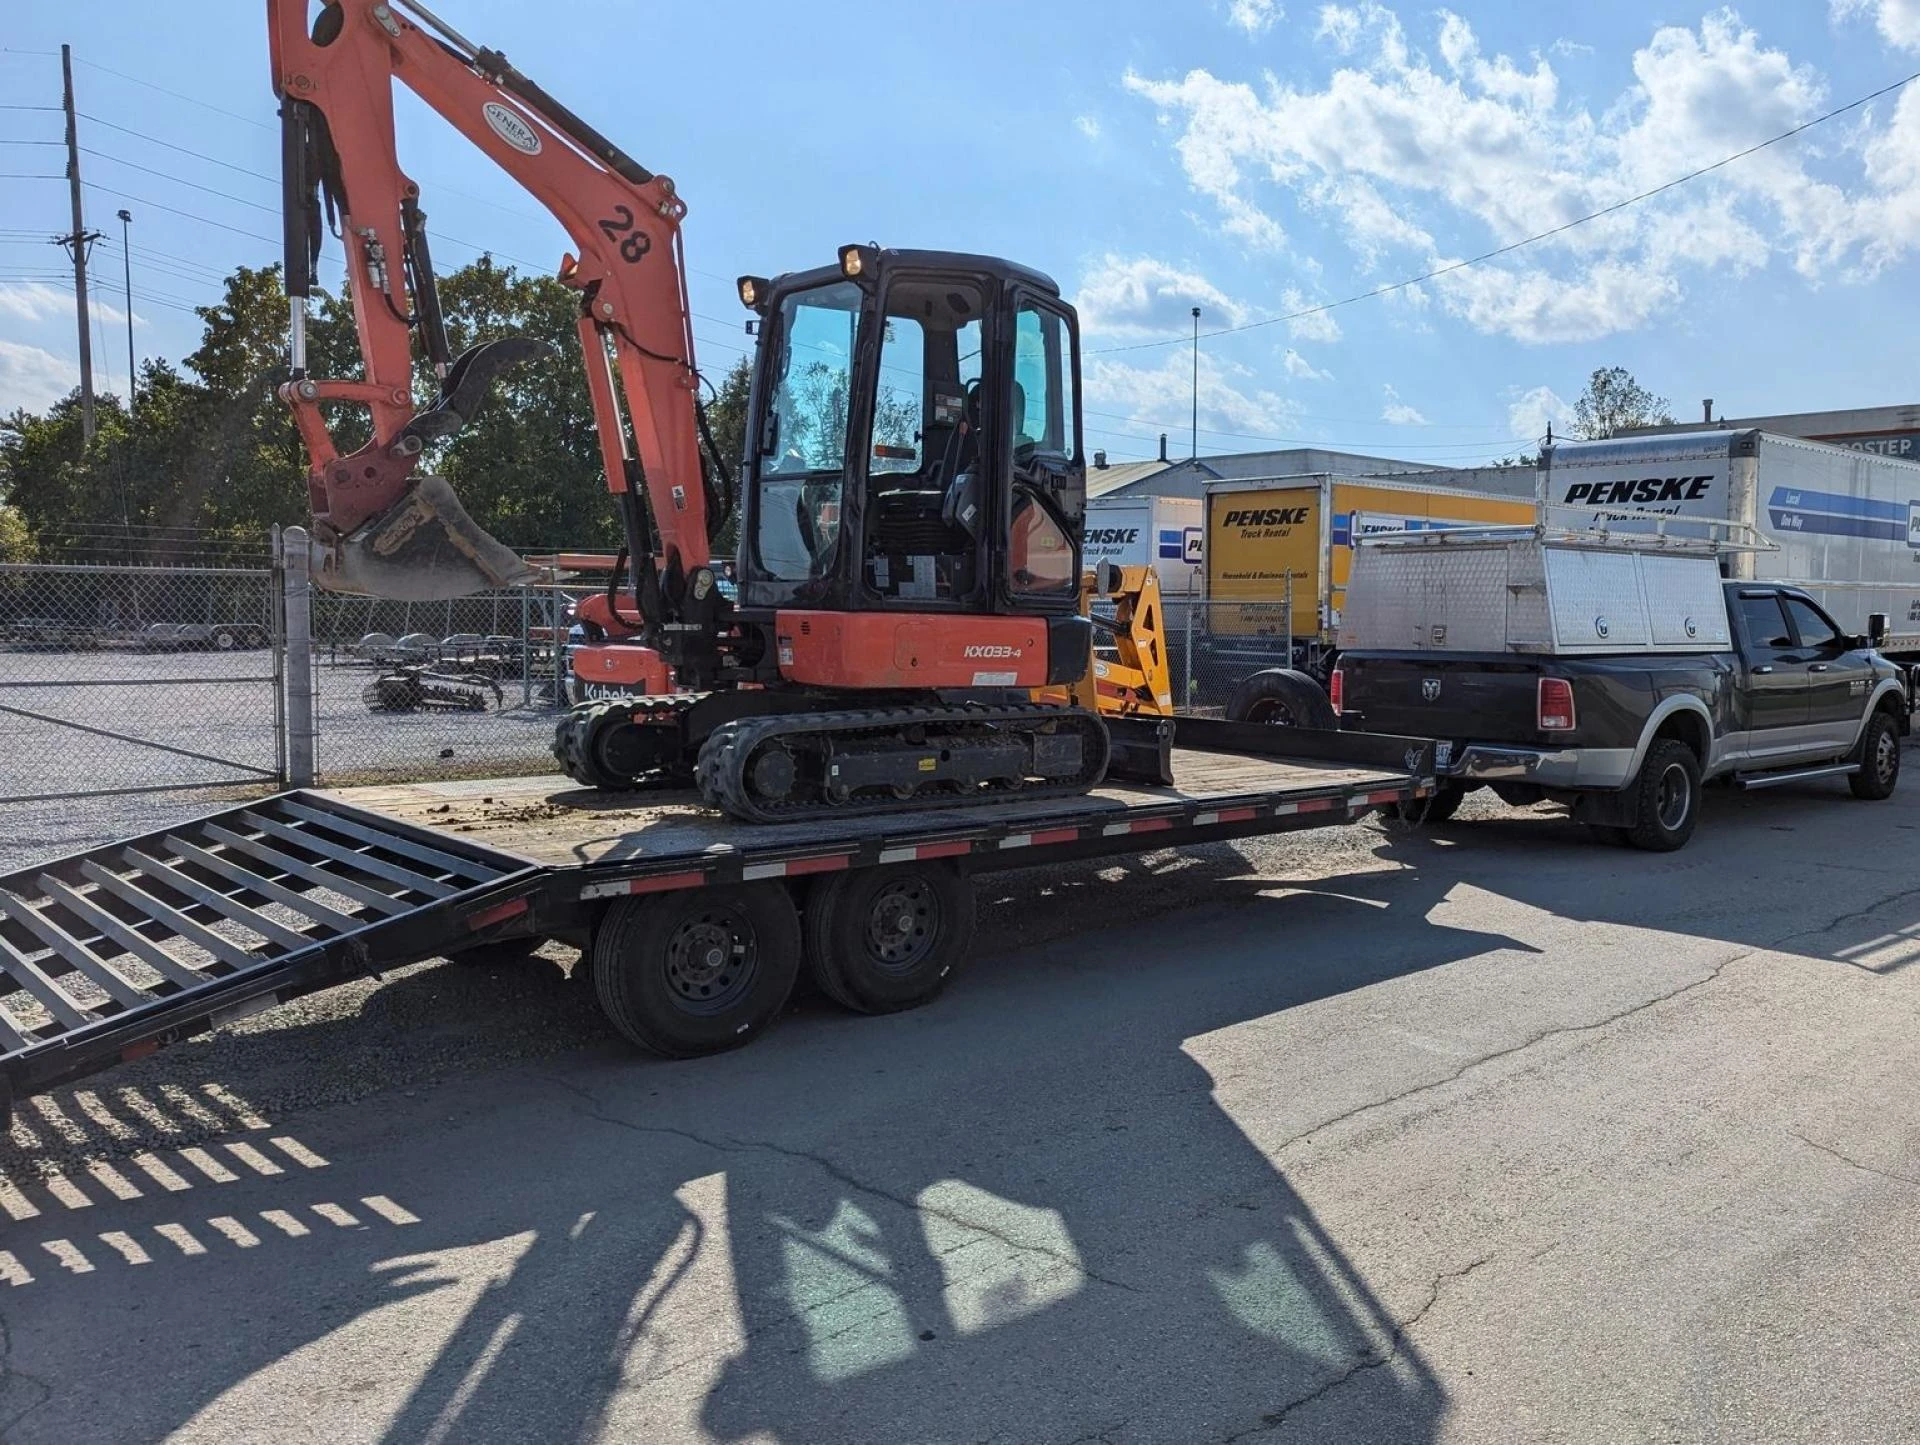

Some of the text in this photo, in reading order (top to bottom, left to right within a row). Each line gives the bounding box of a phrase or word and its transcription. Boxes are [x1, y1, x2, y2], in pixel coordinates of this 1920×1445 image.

[486, 104, 539, 148] GENERAL
[598, 204, 651, 264] 28
[1564, 475, 1715, 505] PENSKE
[1222, 507, 1310, 527] PENSKE
[1593, 504, 1681, 521] Tuck Rtal
[1084, 528, 1139, 545] ENSKE
[1240, 527, 1292, 539] Truck Rental
[1101, 546, 1124, 556] Rental
[1286, 571, 1308, 579] entals
[963, 645, 1022, 658] KX033-4
